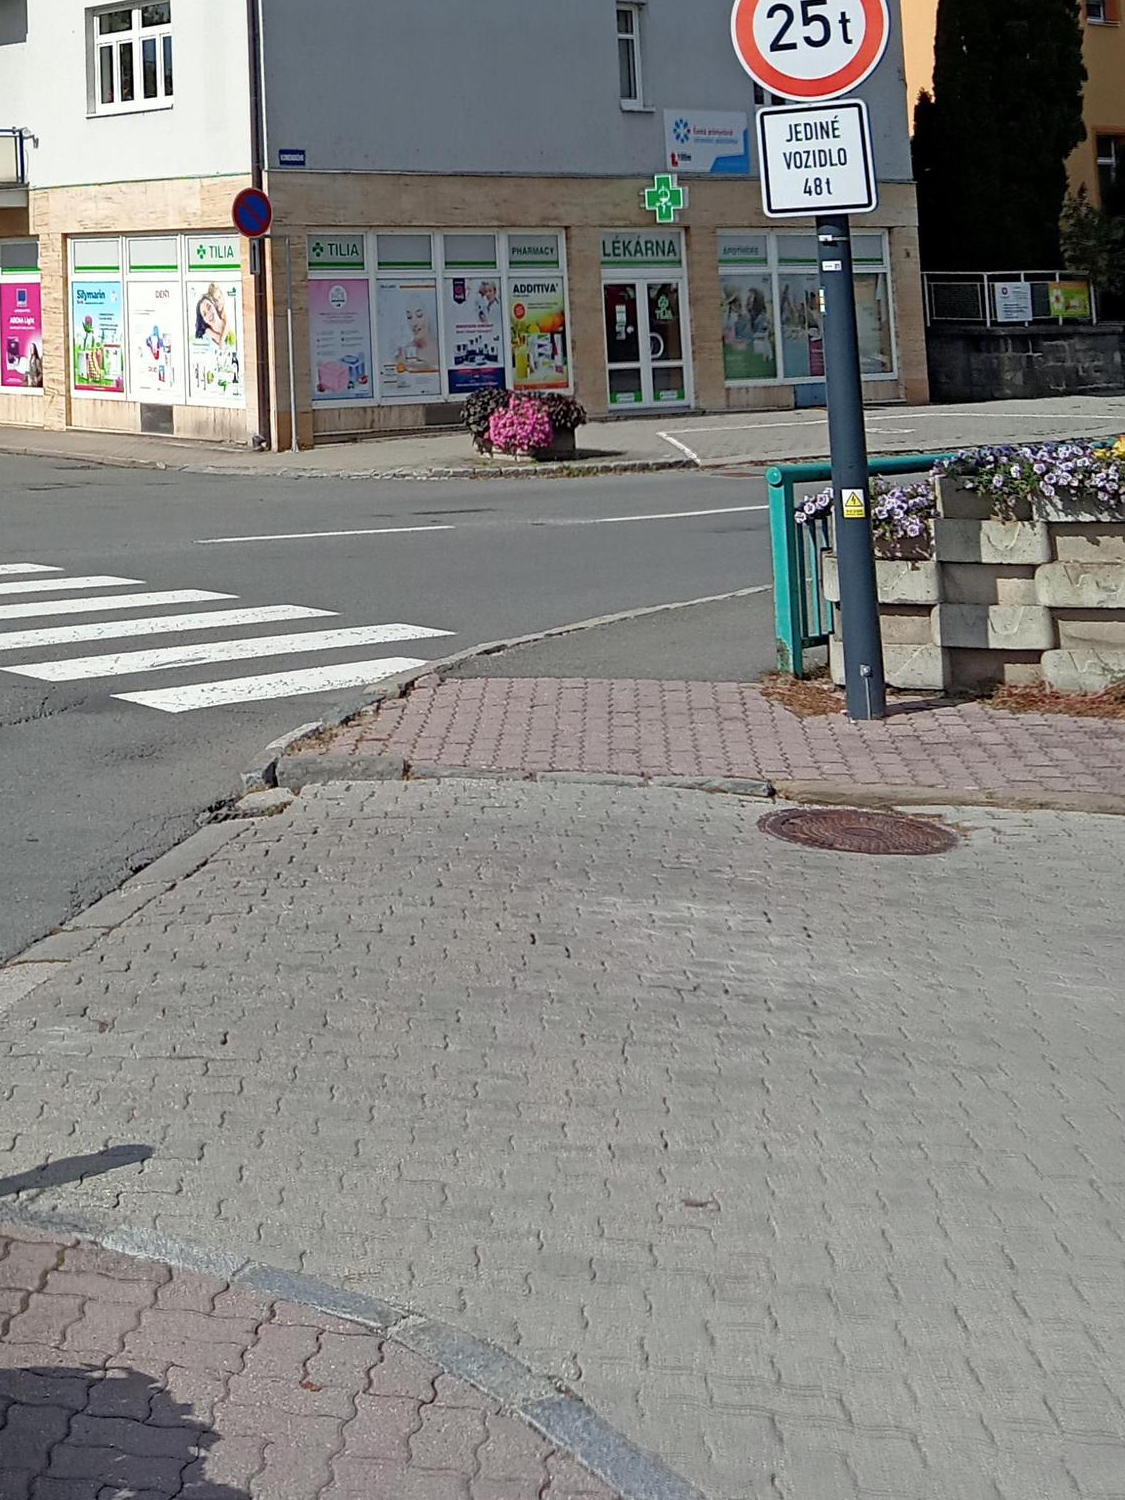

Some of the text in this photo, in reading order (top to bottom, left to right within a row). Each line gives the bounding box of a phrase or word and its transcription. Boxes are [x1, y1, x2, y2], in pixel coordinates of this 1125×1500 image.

[785, 115, 841, 142] JEDINÉ
[783, 147, 847, 170] VOZIDLO
[209, 245, 234, 258] TILIA
[327, 243, 359, 256] TILIA
[511, 246, 554, 255] PHARMACY
[602, 235, 677, 257] LÉKÁRNA
